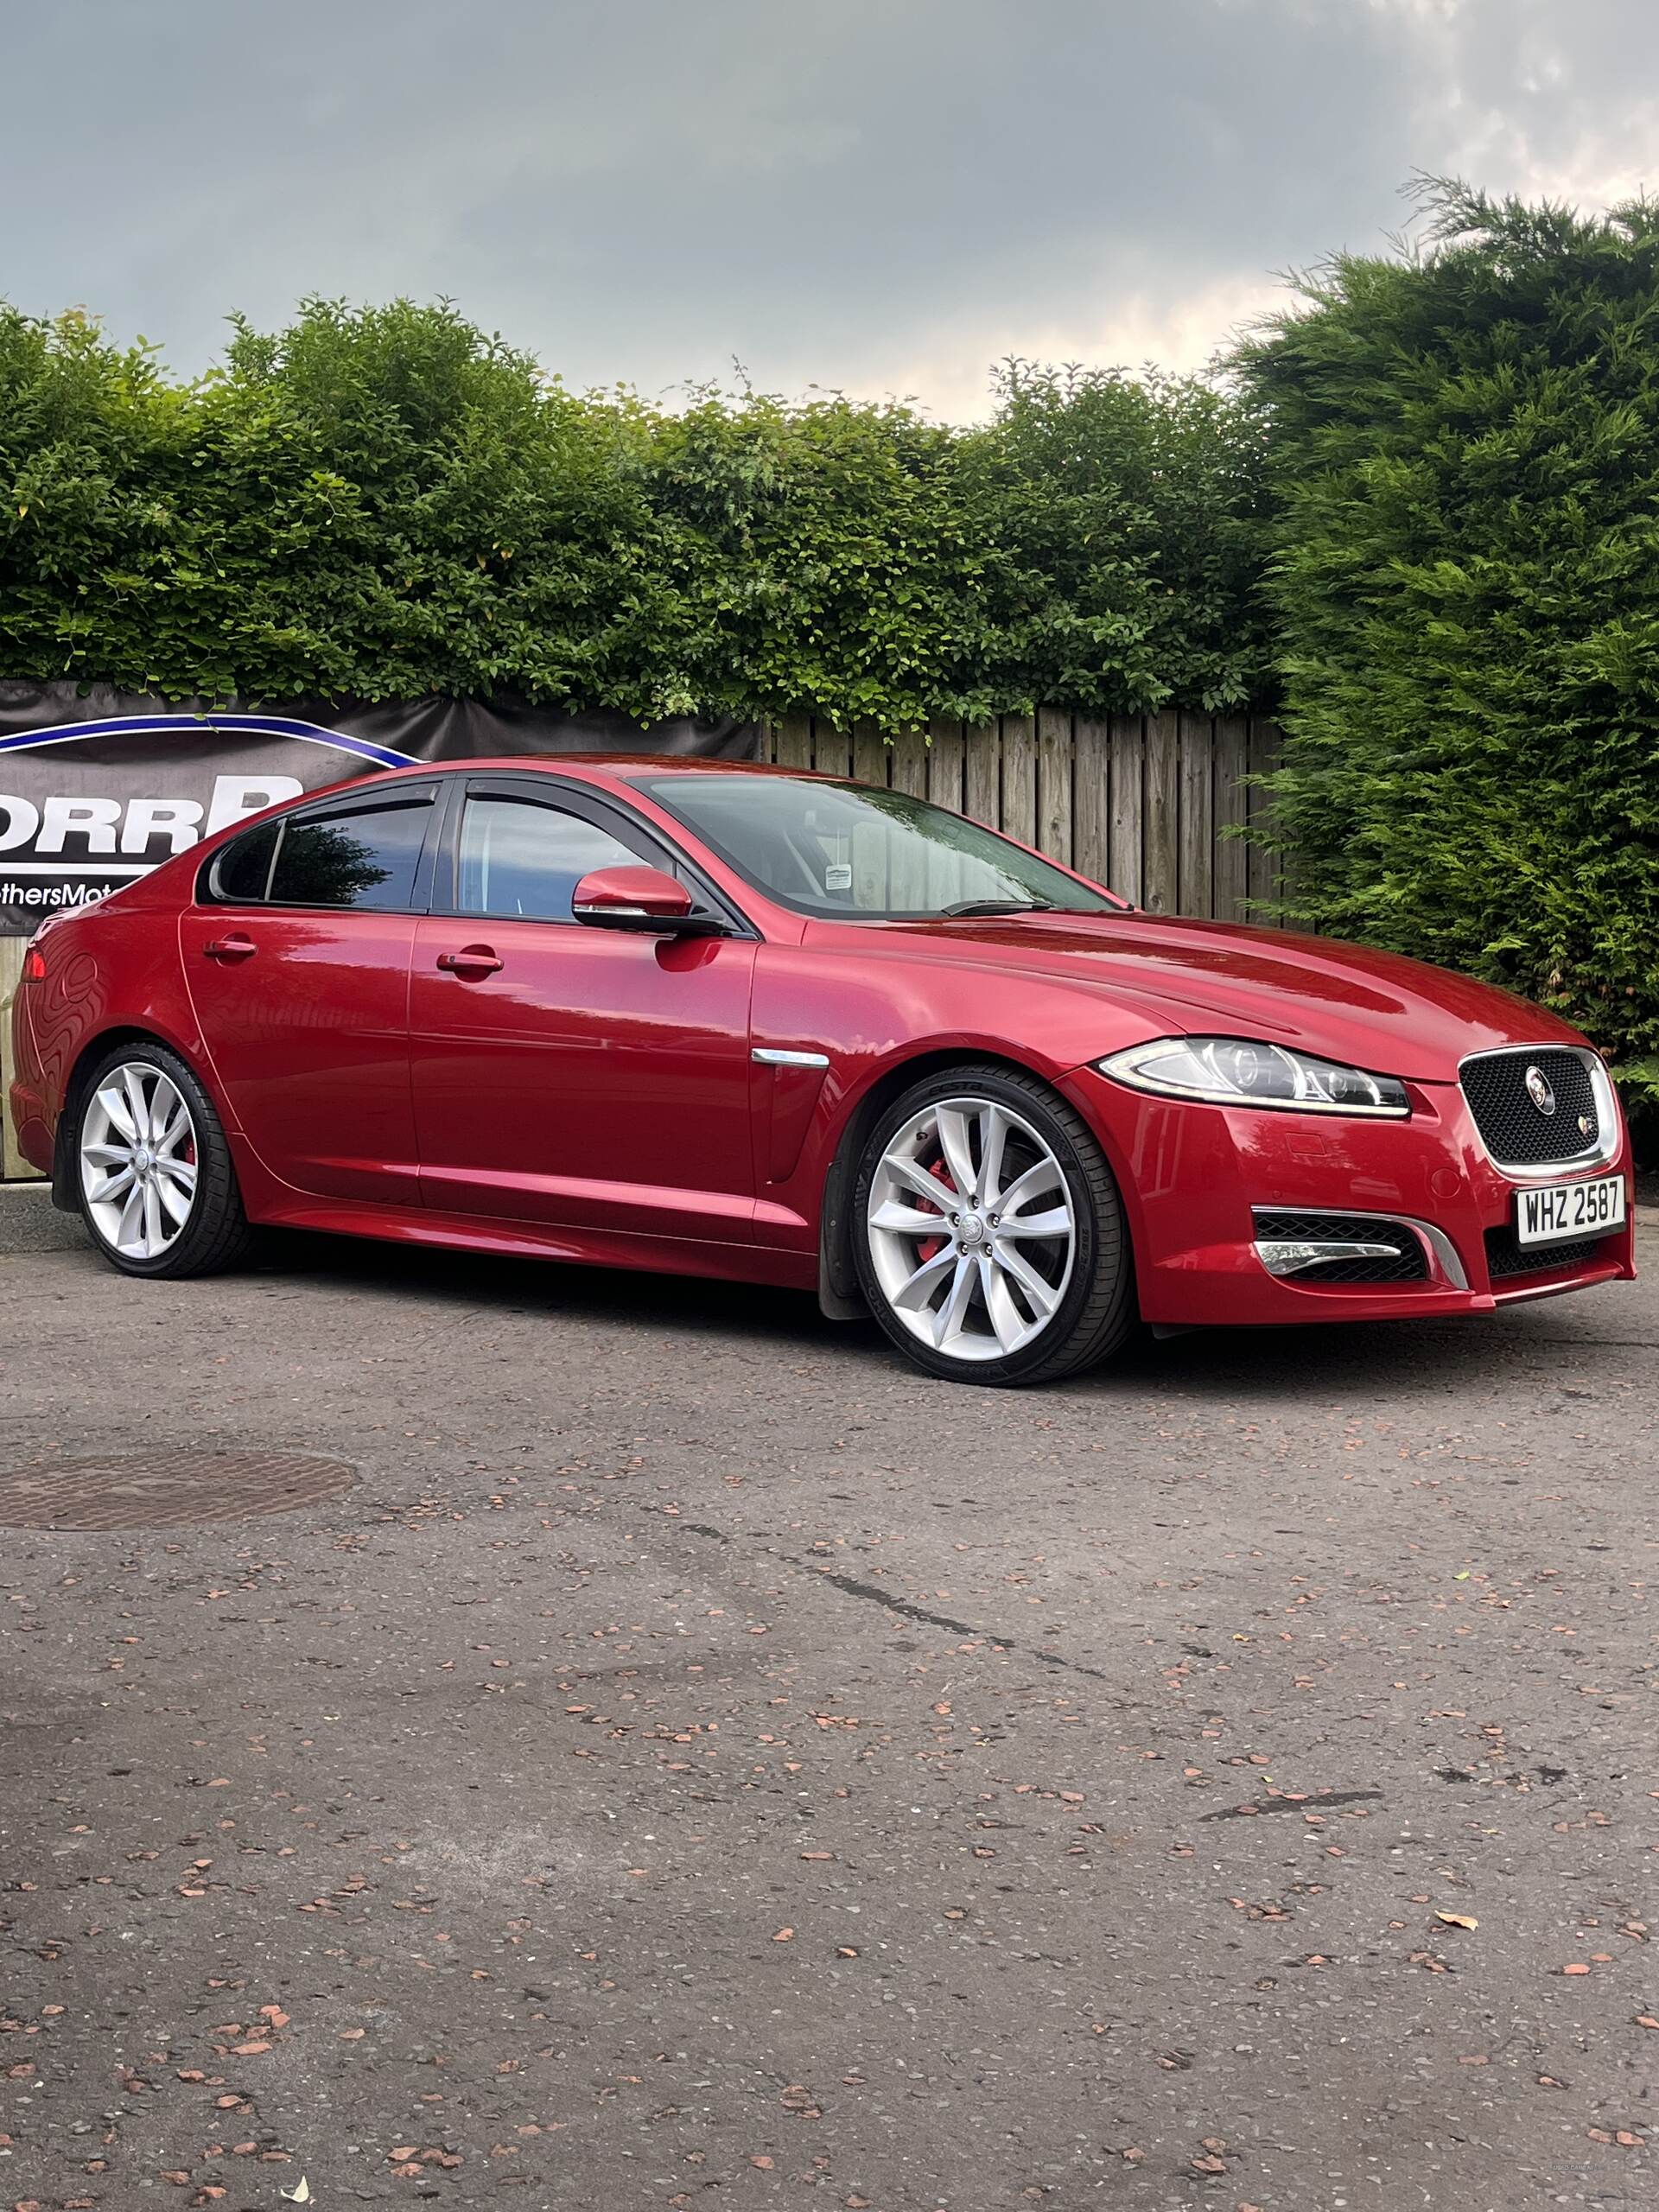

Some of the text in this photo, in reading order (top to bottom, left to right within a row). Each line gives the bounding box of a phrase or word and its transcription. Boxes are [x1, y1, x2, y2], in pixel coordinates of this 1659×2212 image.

[0, 883, 122, 906] thersMot
[1526, 1180, 1618, 1233] WHZ 2587
